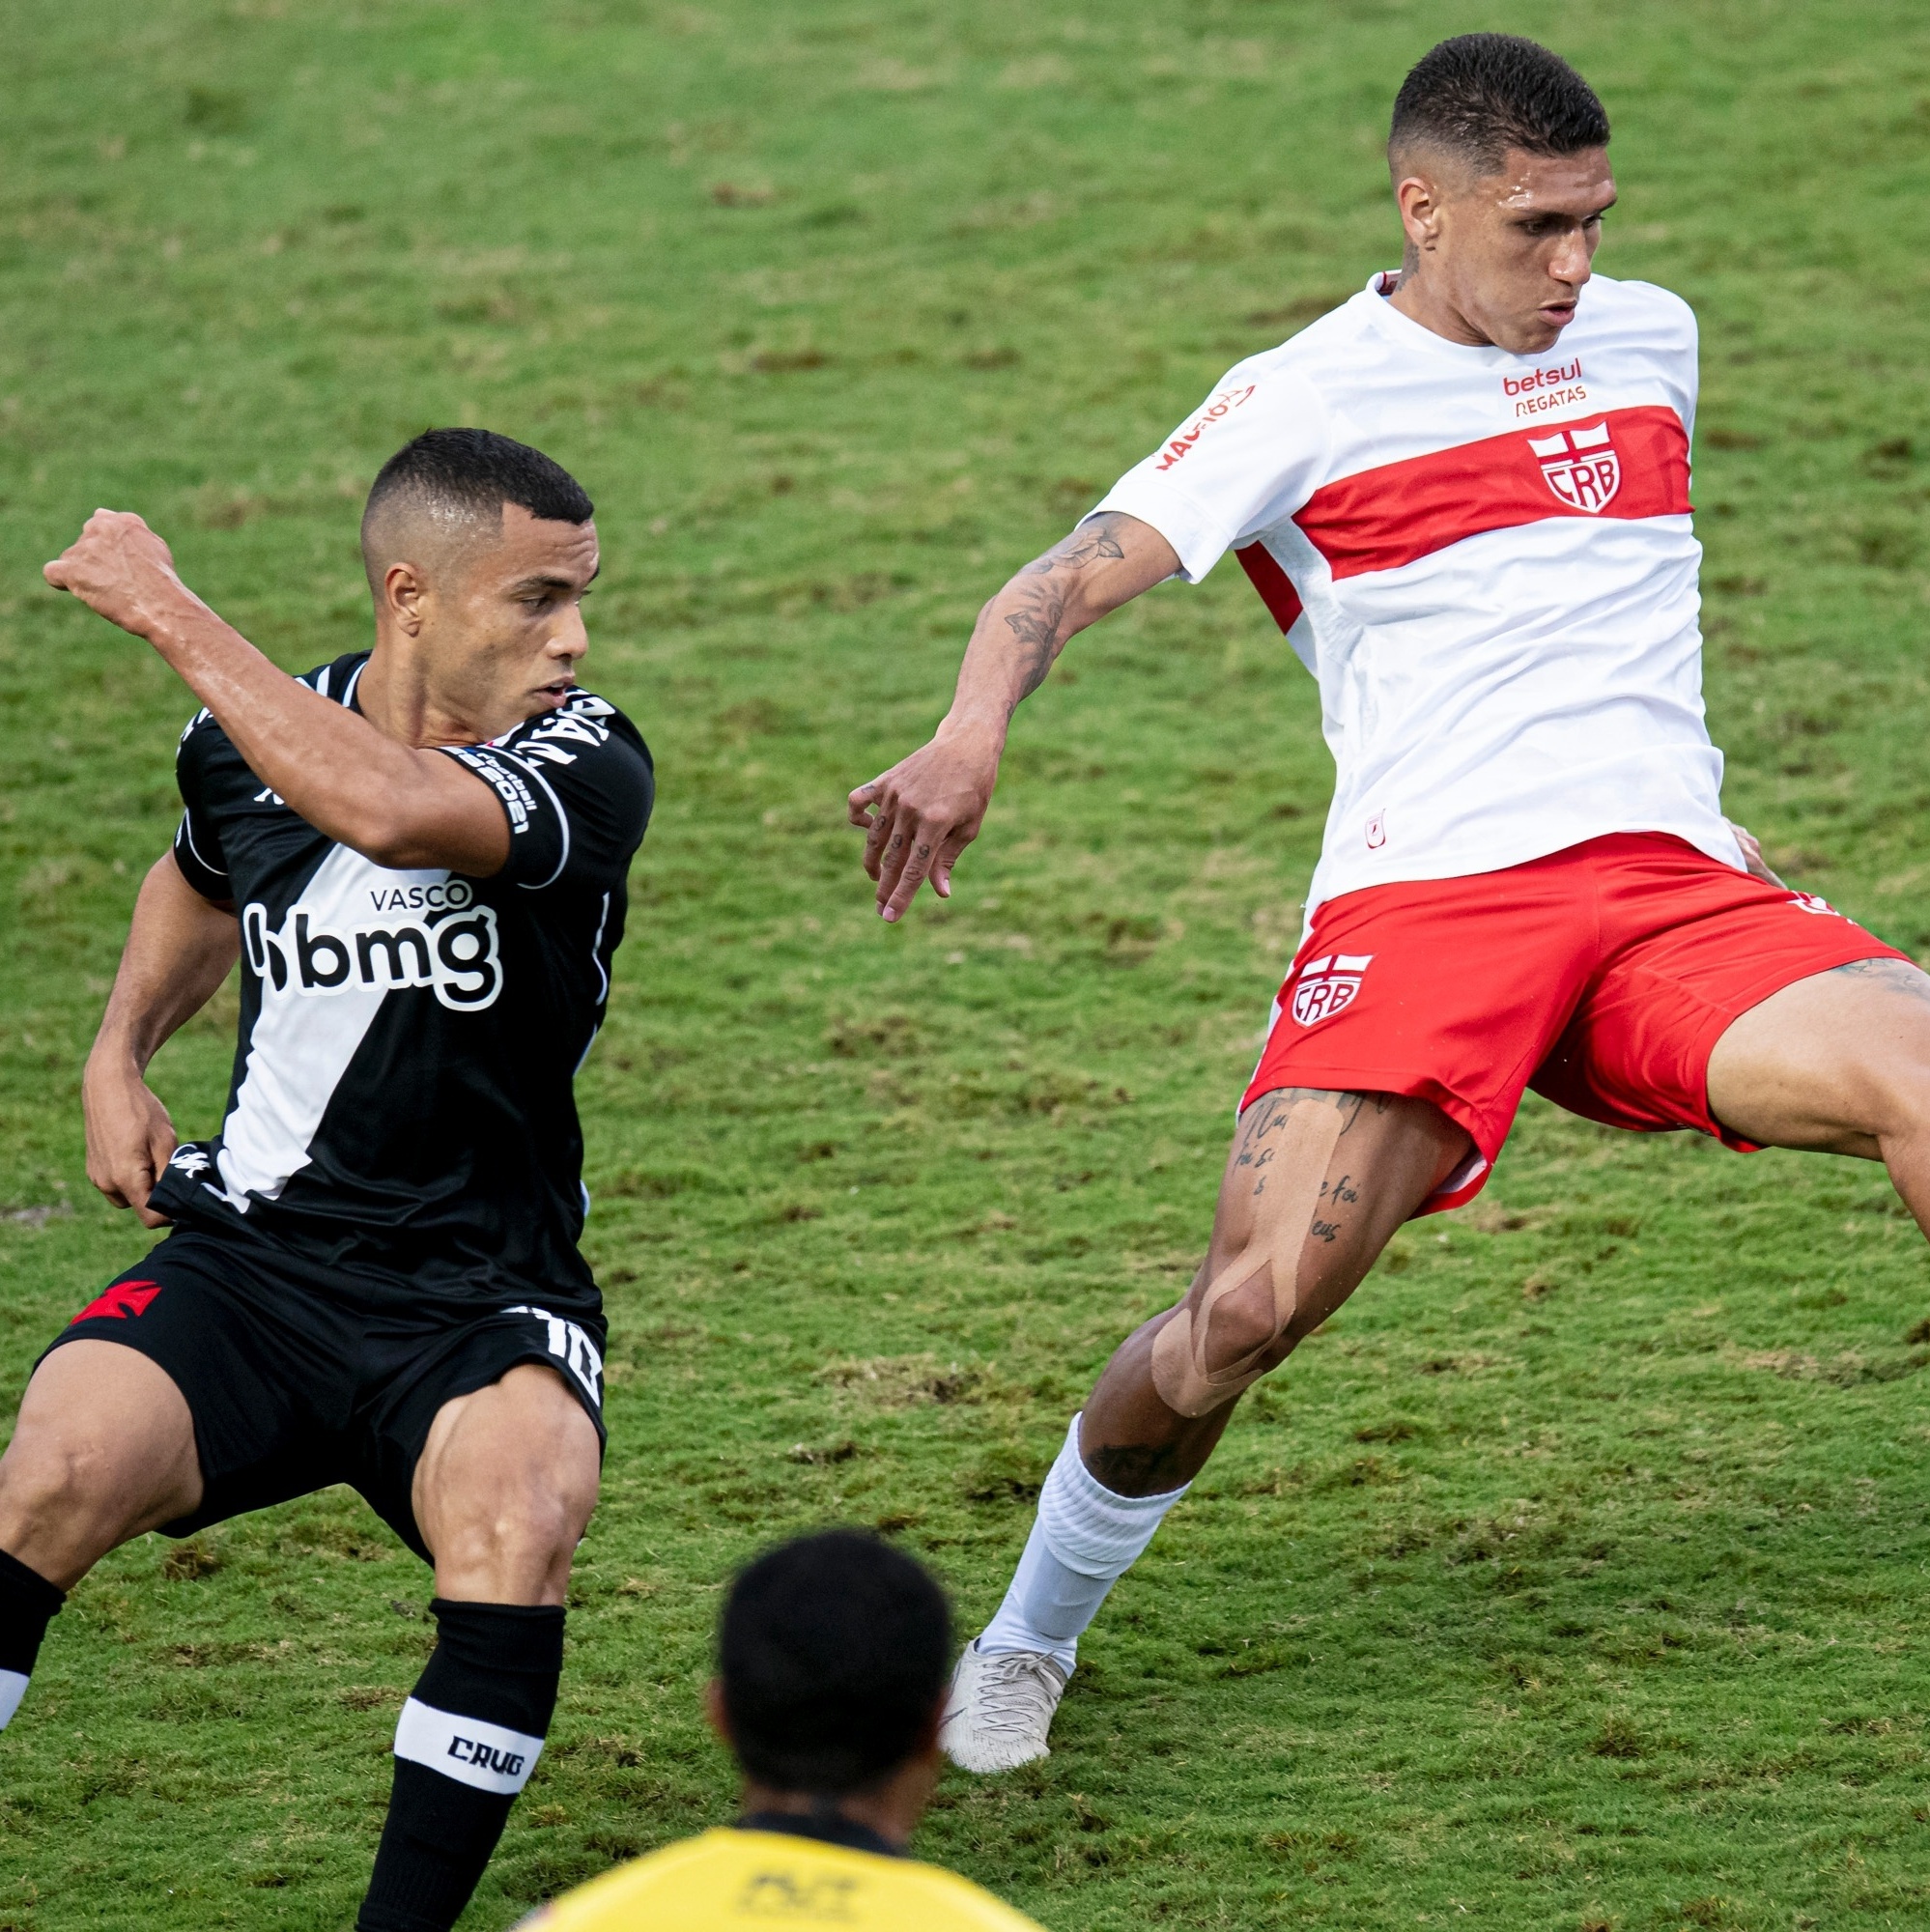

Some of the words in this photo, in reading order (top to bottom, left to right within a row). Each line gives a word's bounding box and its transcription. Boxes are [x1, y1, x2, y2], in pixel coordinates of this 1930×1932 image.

[1503, 357, 1582, 396] betsul
[1516, 385, 1586, 417] REGATAS
[1547, 459, 1616, 509] CRB
[513, 689, 616, 767] AVAN
[370, 883, 470, 911] VASCO
[295, 913, 497, 1003] bmg
[1295, 983, 1354, 1022] CRB
